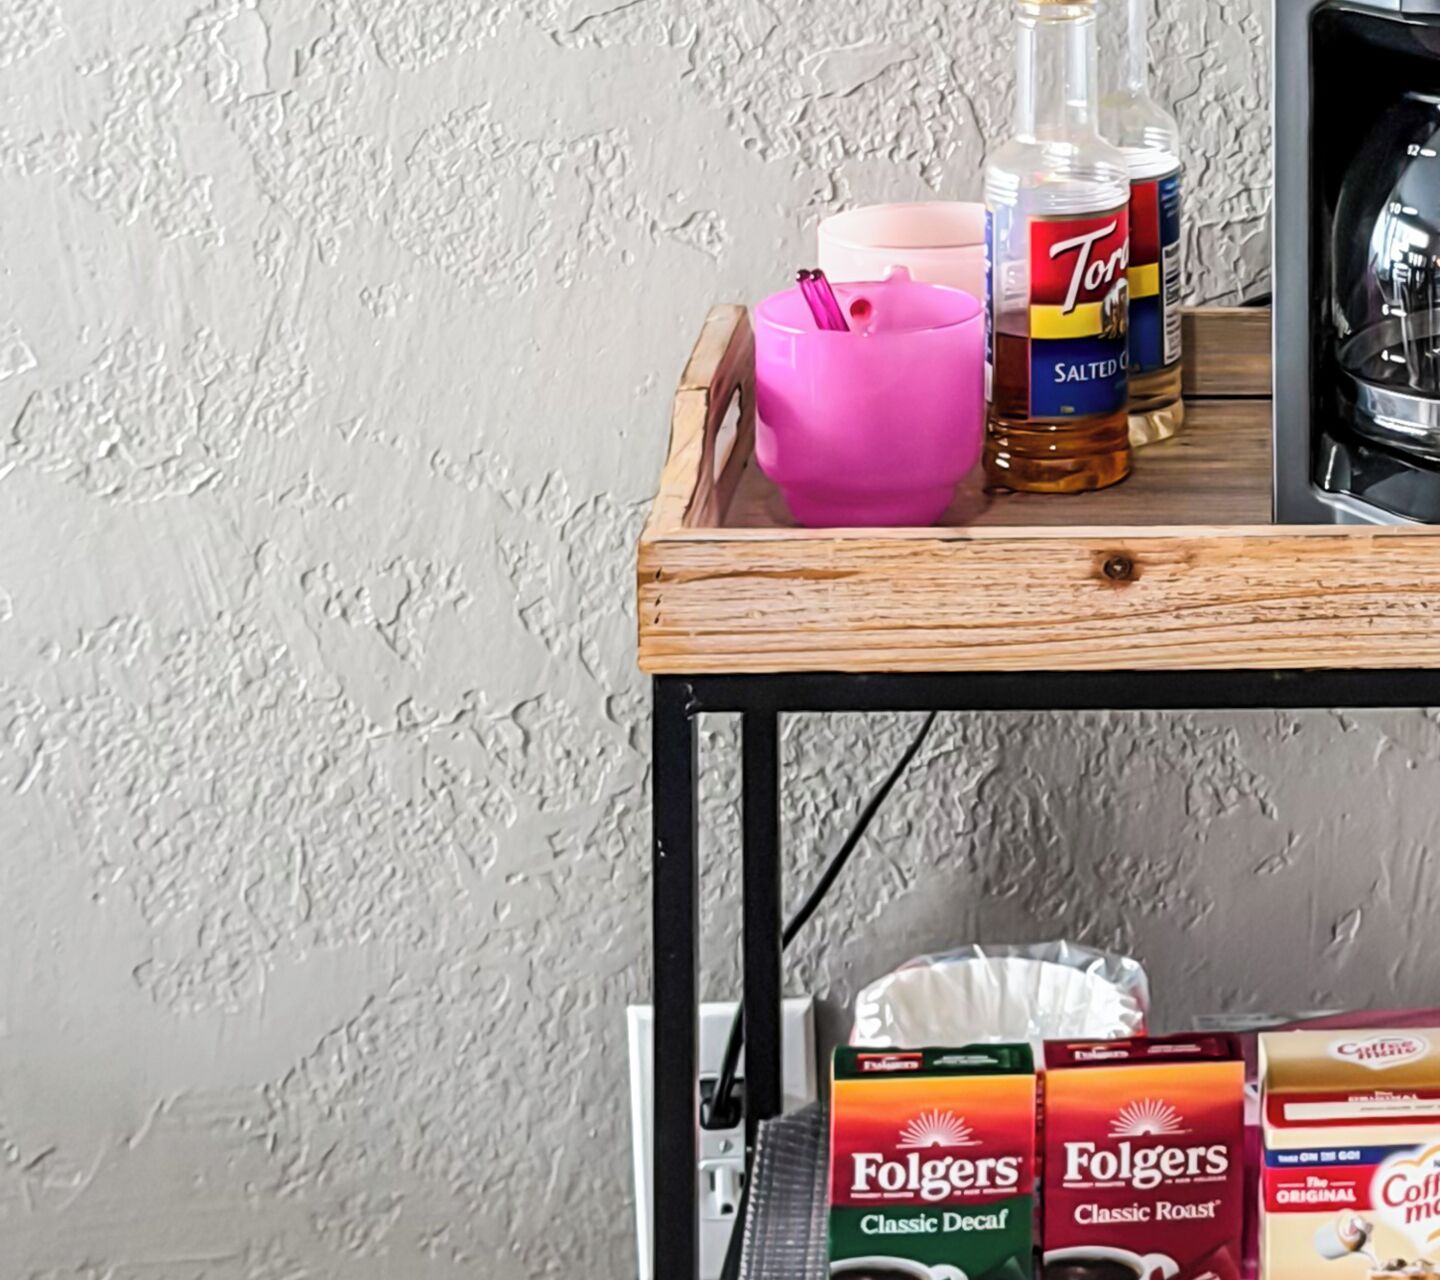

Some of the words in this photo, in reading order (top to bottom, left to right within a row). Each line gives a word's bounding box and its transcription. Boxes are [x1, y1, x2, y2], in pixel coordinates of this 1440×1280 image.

[1407, 144, 1420, 156] 12
[1054, 358, 1117, 383] SALTED
[851, 1152, 1020, 1202] Folgers
[1063, 1141, 1229, 1190] Folgers
[1276, 1188, 1357, 1204] ORIGINAL
[860, 1213, 938, 1235] Classic
[942, 1208, 1009, 1231] Decaf
[1074, 1203, 1150, 1225] Classic
[1155, 1200, 1216, 1221] Roast
